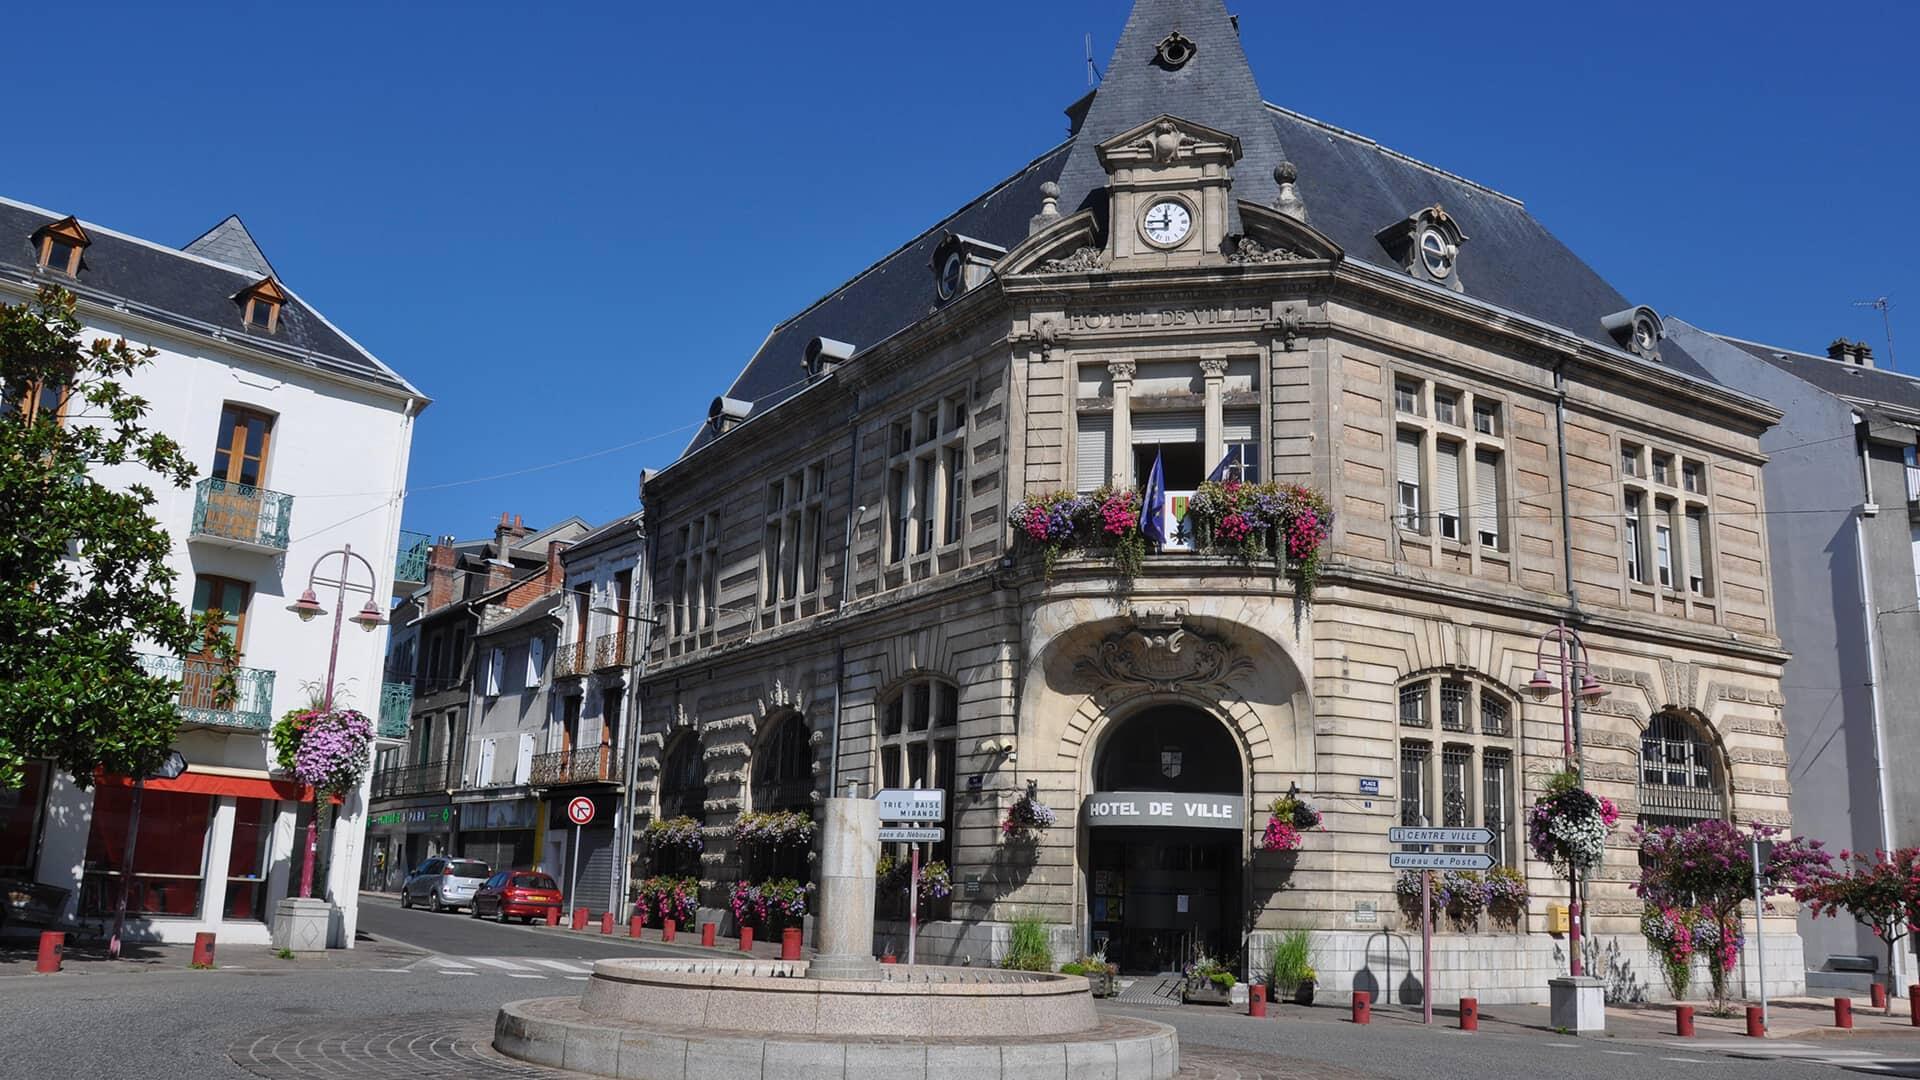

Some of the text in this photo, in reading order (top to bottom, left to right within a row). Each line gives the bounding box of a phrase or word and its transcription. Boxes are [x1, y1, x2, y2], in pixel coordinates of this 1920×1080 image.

[1069, 306, 1268, 330] HOTEL DE VILLE
[1090, 802, 1233, 818] HOTEL DE VILLE
[1407, 831, 1446, 840] CENTRE
[1451, 832, 1477, 840] VILLE
[1394, 856, 1478, 866] Bureau de Poste
